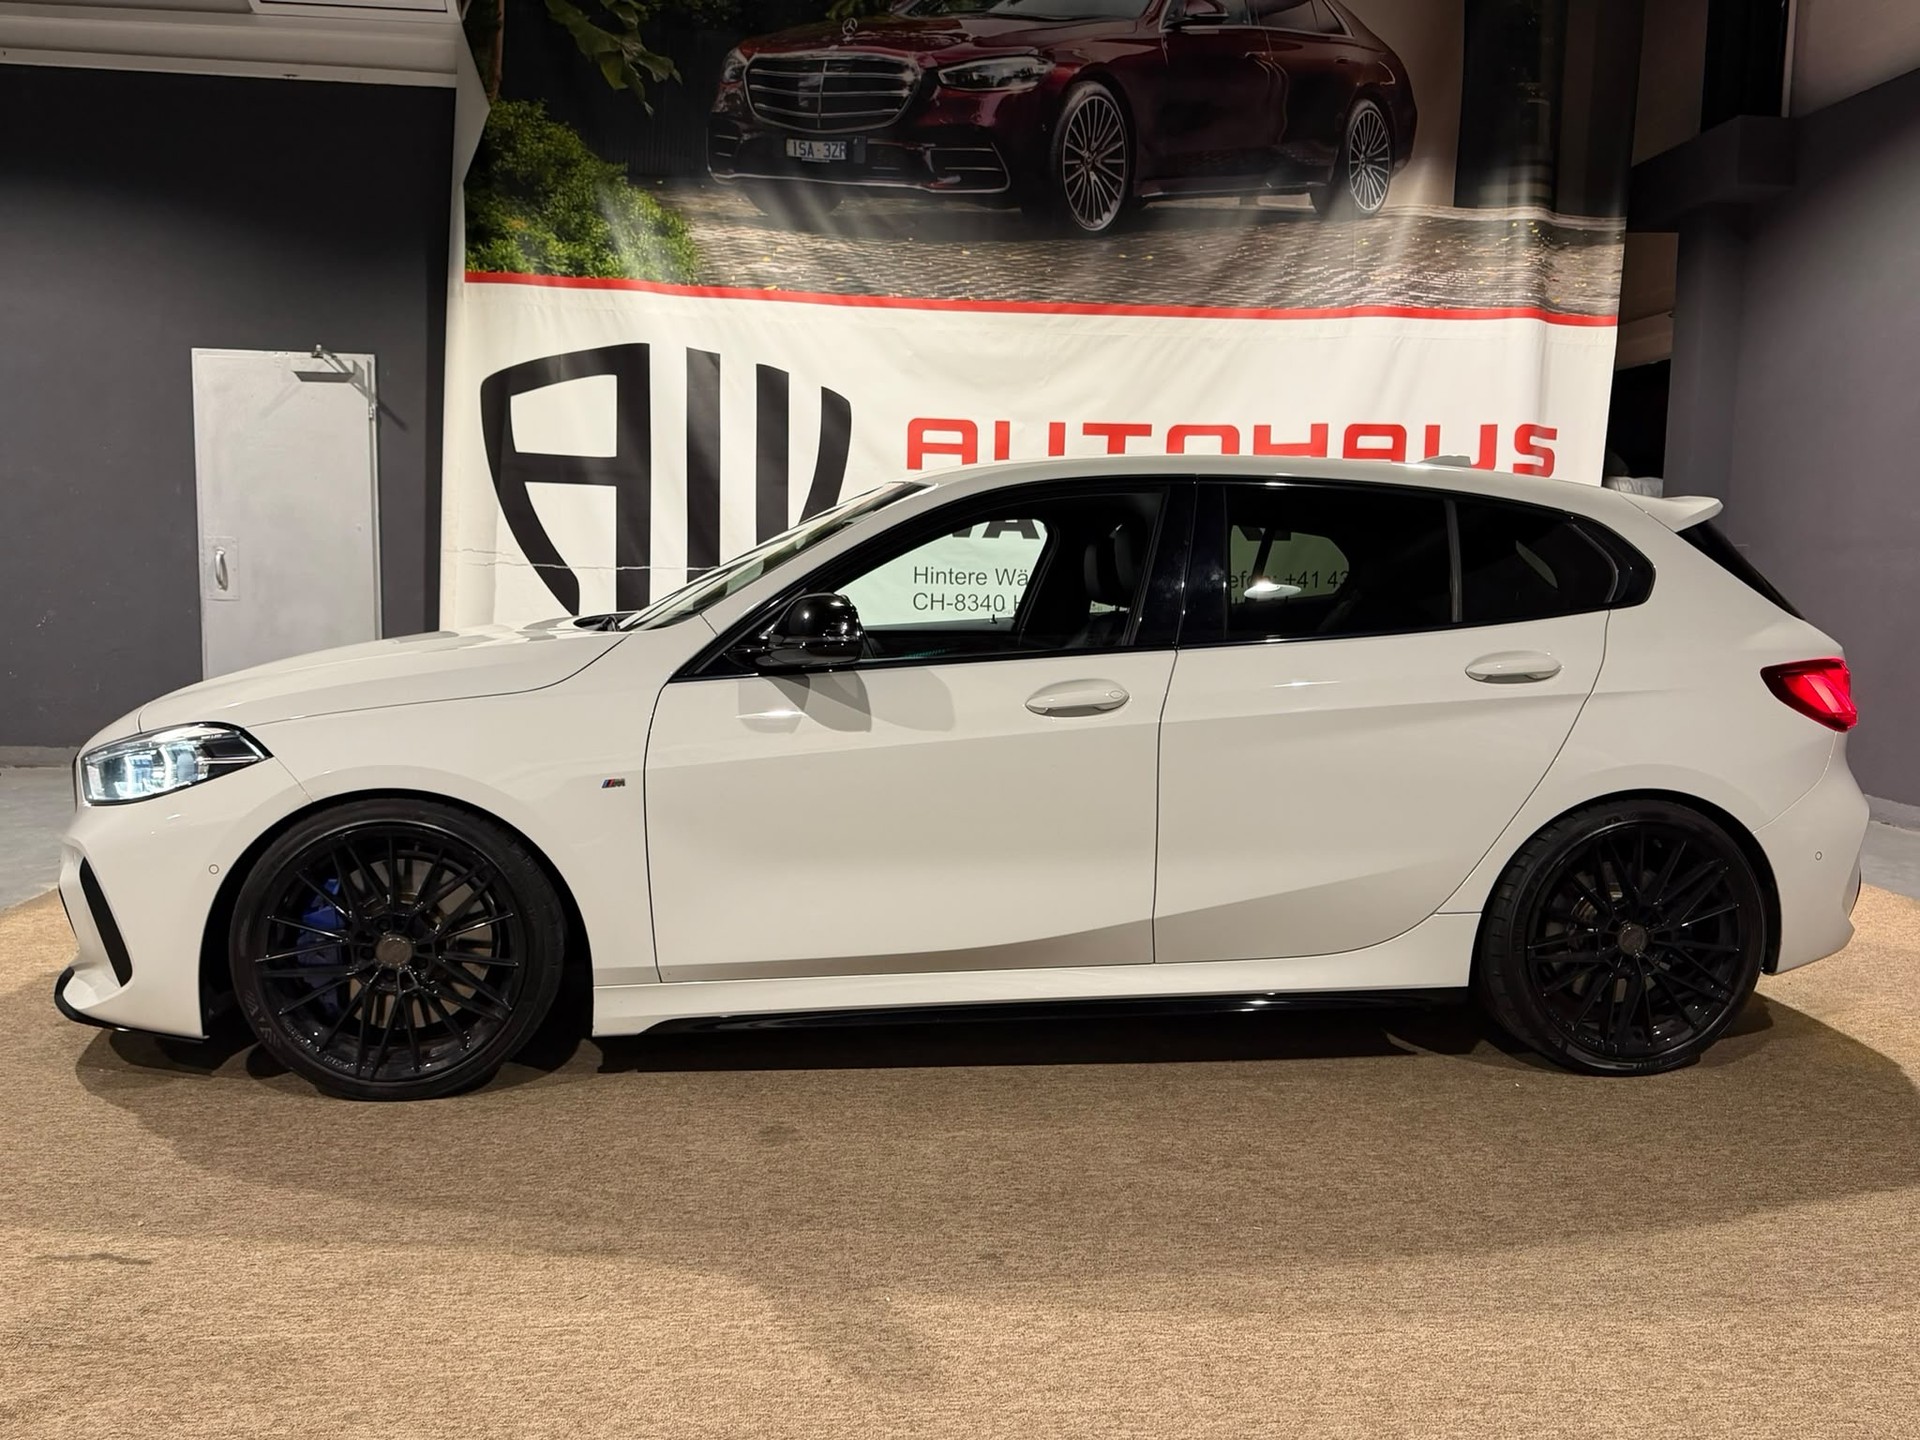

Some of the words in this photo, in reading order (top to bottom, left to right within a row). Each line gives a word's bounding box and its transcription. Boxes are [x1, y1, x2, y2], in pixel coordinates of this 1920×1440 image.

[907, 417, 1558, 478] AUTOHAUS
[914, 566, 988, 586] Hintere
[1284, 570, 1319, 588] +41
[913, 592, 1006, 613] CH-8340
